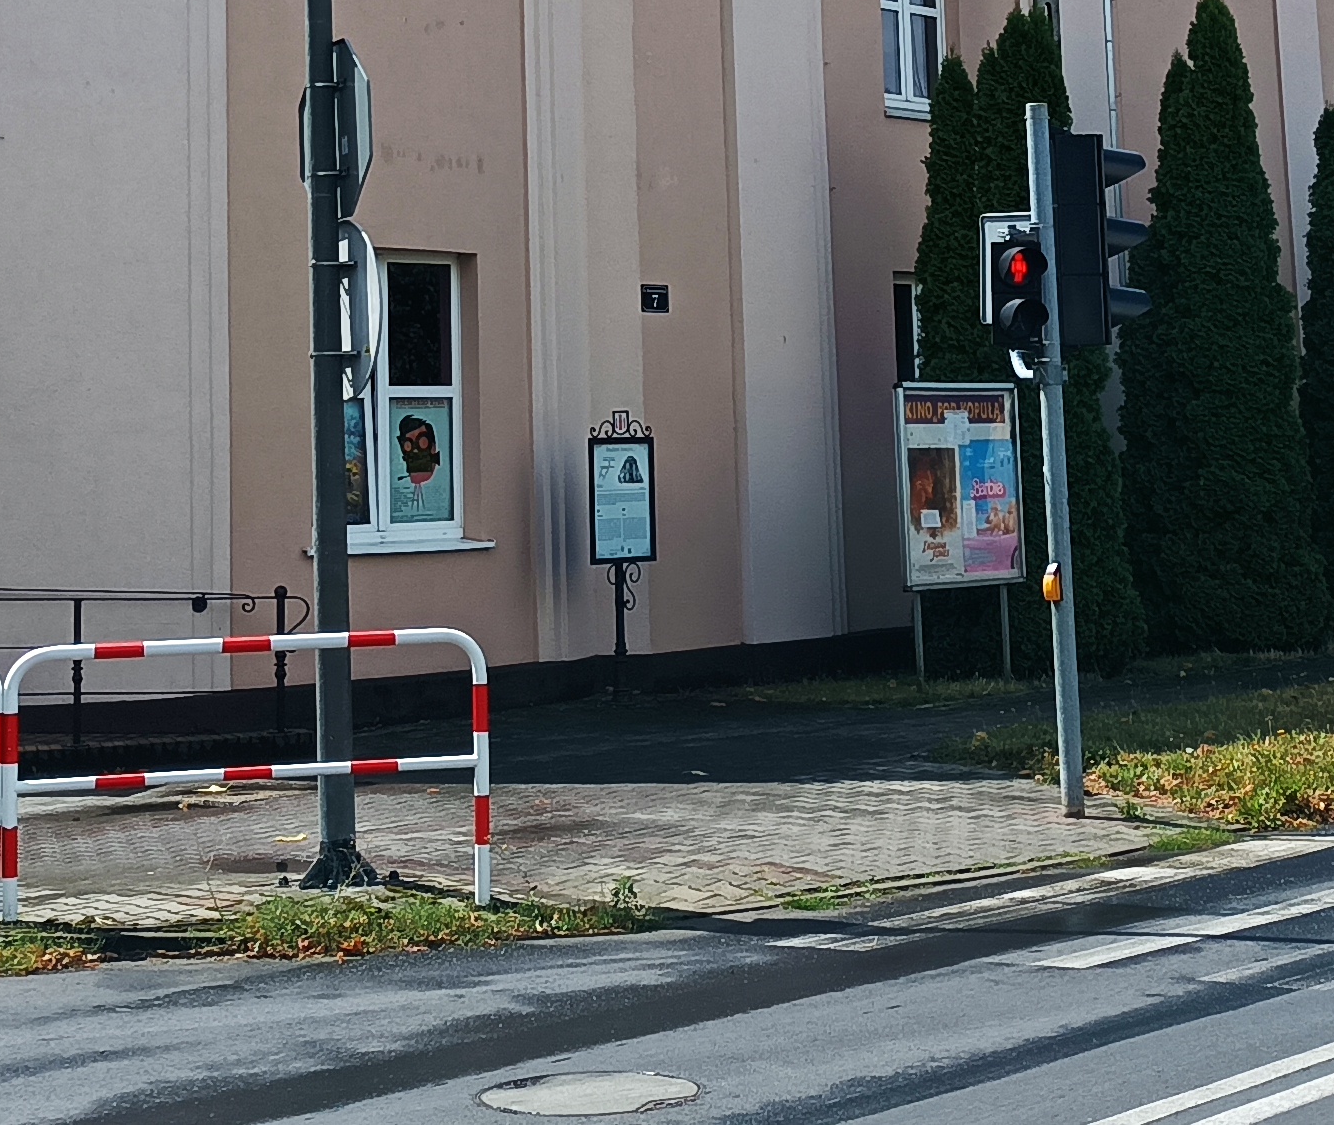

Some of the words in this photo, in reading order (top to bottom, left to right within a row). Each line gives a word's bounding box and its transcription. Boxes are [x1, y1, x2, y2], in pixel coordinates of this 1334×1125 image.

[651, 294, 659, 308] 7
[906, 401, 933, 419] KINO
[970, 478, 1004, 497] Barbie
